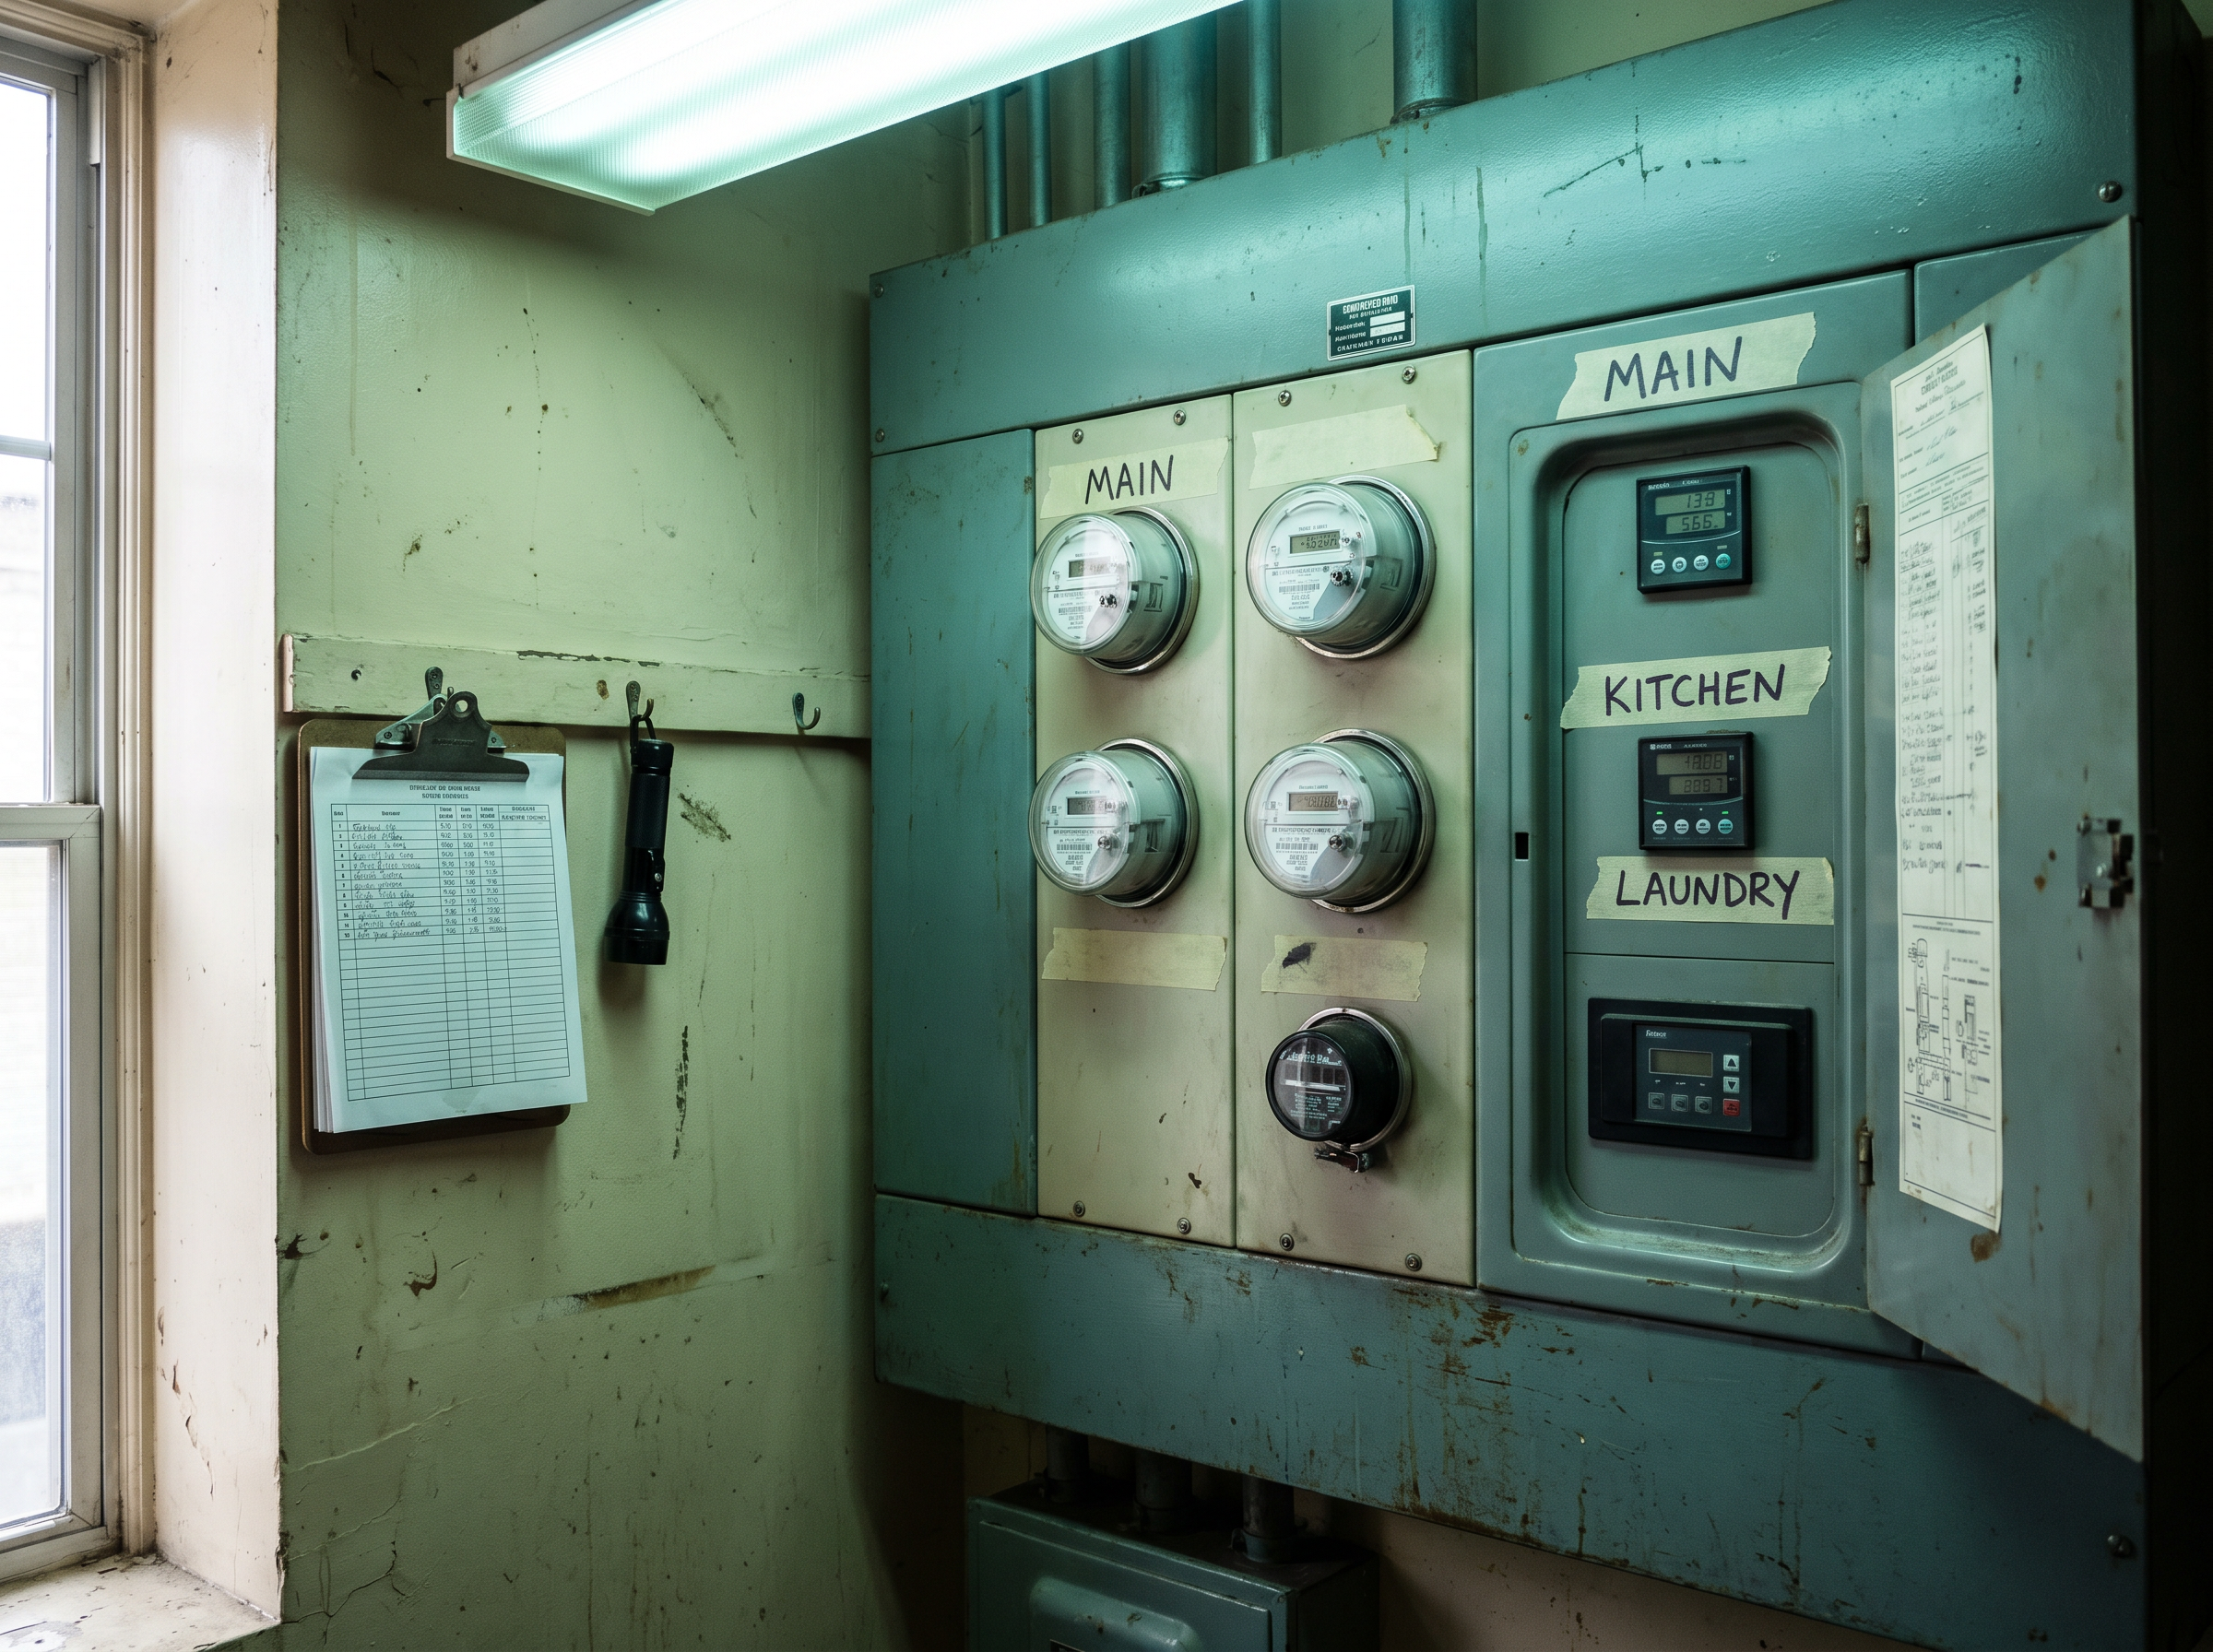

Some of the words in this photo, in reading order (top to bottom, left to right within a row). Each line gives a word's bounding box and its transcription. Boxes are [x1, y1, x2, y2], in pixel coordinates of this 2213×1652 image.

[1604, 336, 1742, 402] MAIN
[1084, 454, 1174, 505] MAIN
[1604, 663, 1785, 716] KITCHEN
[1615, 869, 1800, 920] LAUNDRY
